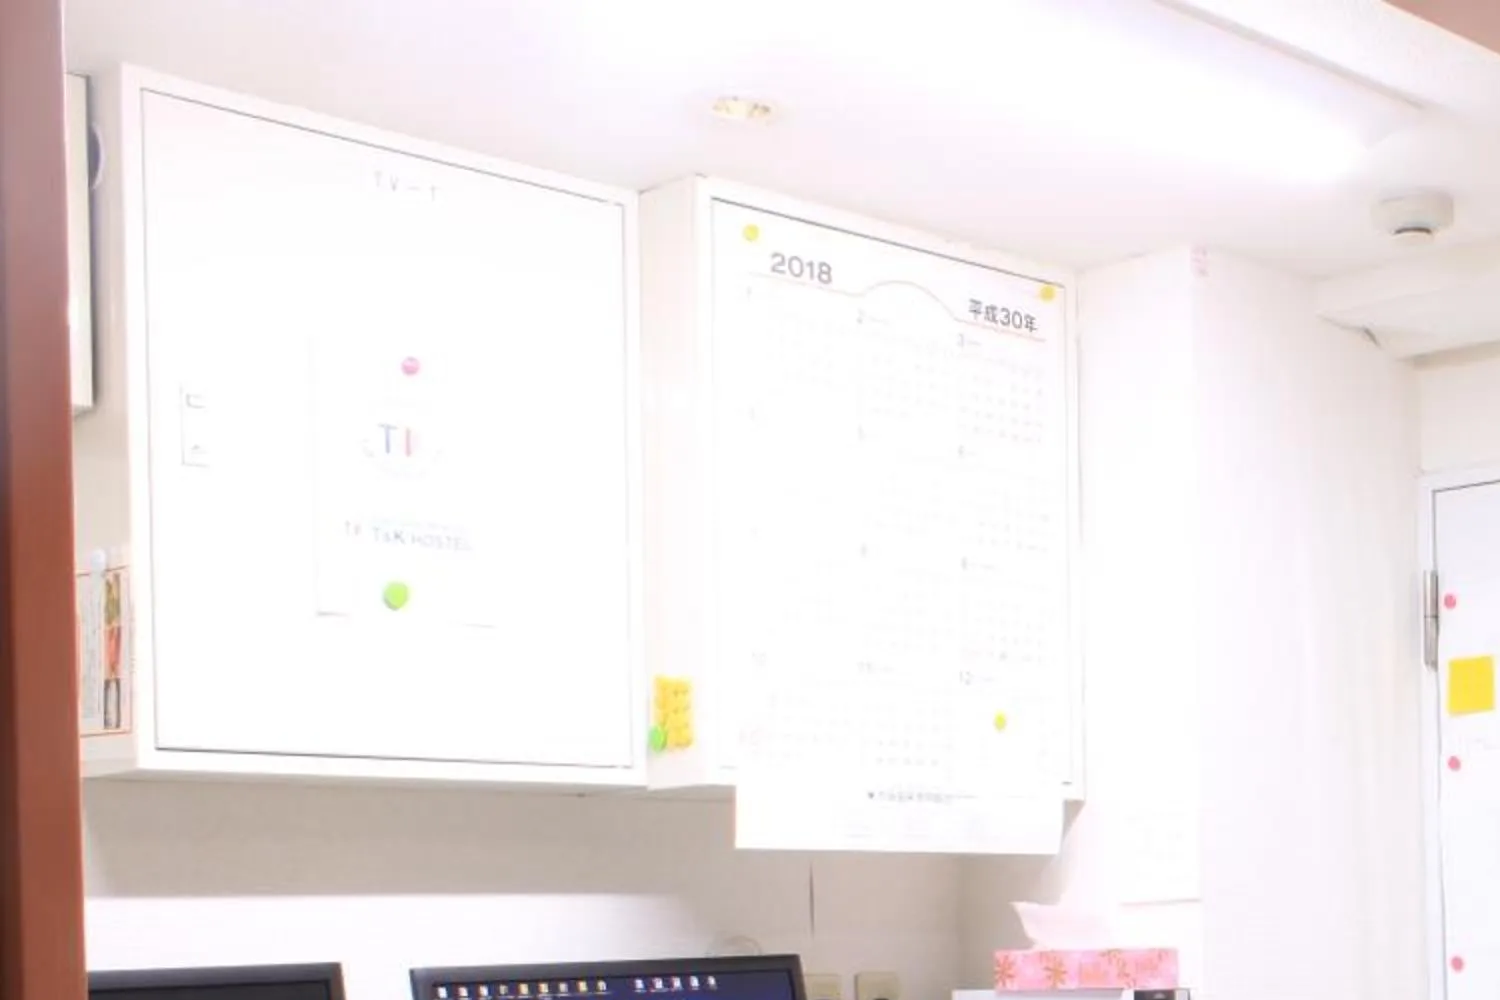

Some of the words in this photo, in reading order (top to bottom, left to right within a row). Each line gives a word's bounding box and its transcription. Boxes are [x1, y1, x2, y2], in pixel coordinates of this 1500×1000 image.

[769, 251, 833, 285] 2018
[967, 297, 1038, 333] 平成30年
